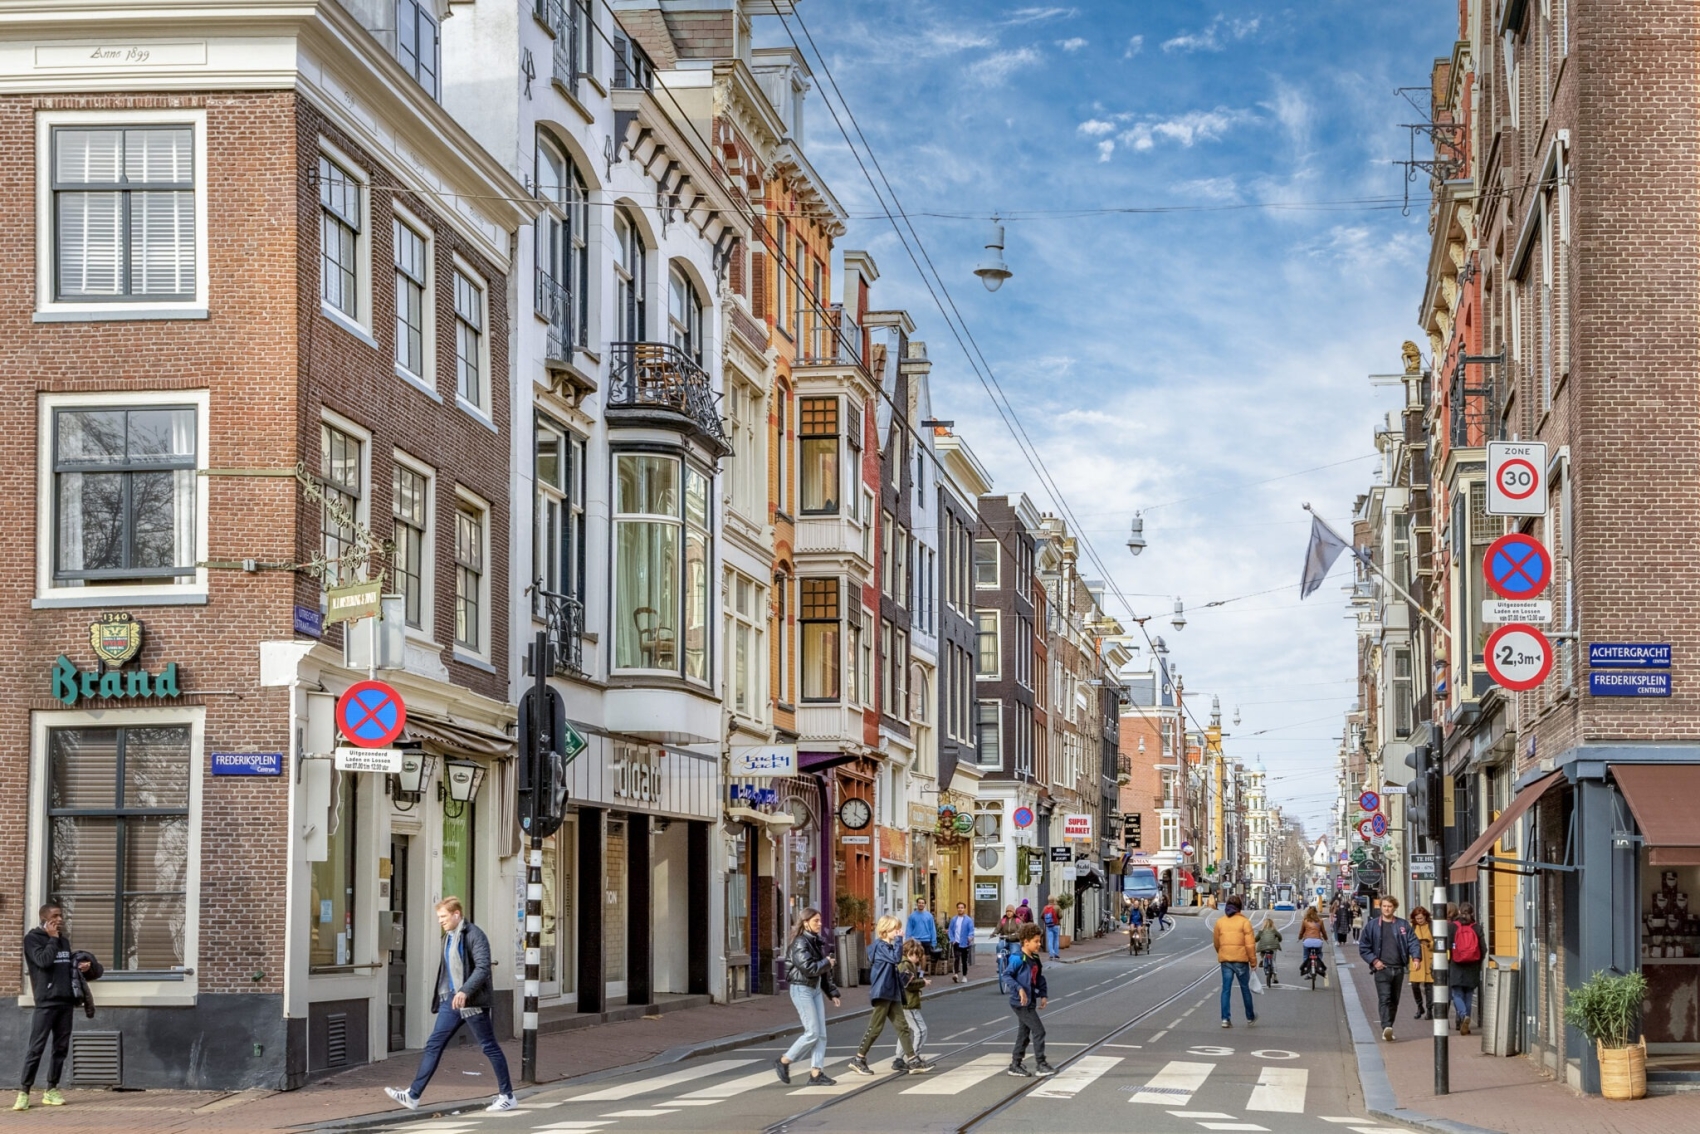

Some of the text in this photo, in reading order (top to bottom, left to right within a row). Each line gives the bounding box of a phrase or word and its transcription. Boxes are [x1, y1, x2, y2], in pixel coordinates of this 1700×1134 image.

[125, 46, 150, 62] 1899
[1504, 447, 1531, 455] ZONE
[1504, 471, 1531, 486] 30
[103, 612, 128, 622] 1340
[1501, 645, 1534, 667] 2,3m
[1591, 647, 1669, 657] ACHTERGRACHT
[52, 654, 180, 705] Brand
[1594, 675, 1667, 685] FREDERIKSPLEIN
[215, 755, 276, 765] FREDERIKSPLEIN
[745, 754, 790, 766] Lucky
[1068, 818, 1088, 826] SUPER
